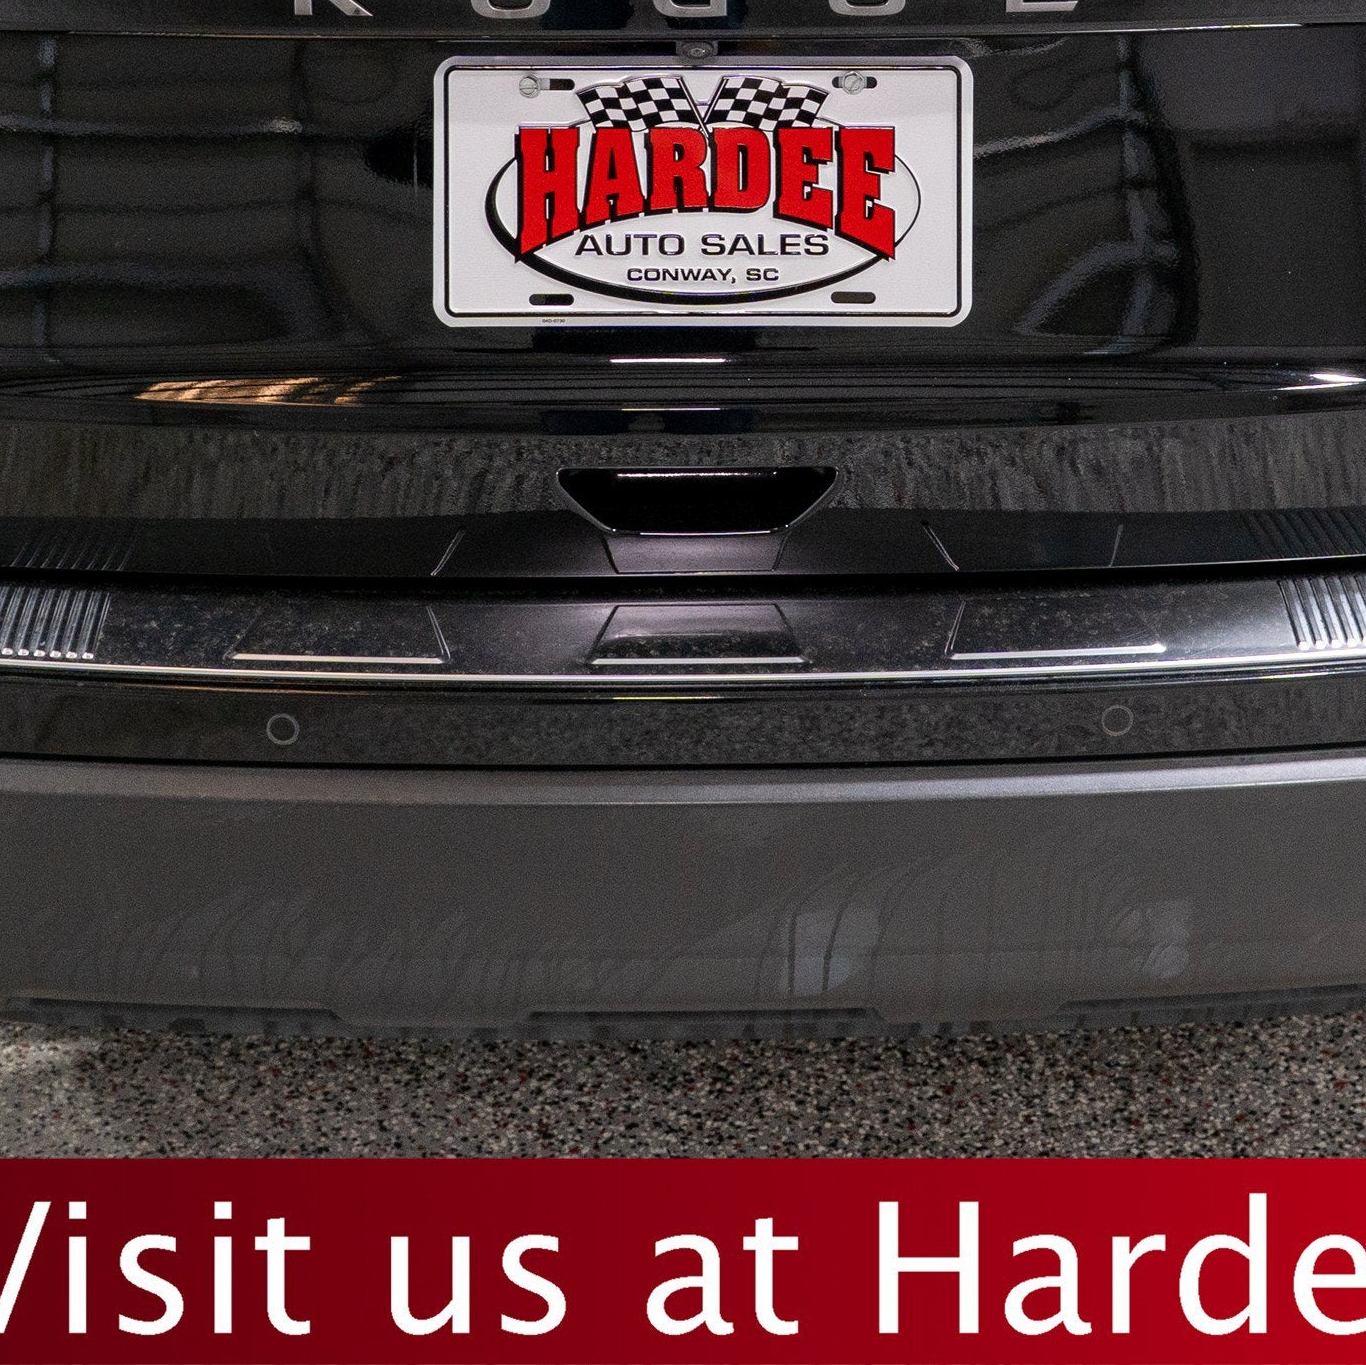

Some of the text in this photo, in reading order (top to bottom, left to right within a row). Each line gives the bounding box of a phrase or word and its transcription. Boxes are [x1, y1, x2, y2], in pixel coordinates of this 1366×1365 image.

[514, 125, 896, 263] HARDEE
[574, 233, 831, 258] AUTO SALES
[626, 267, 780, 284] CONWAY, SC
